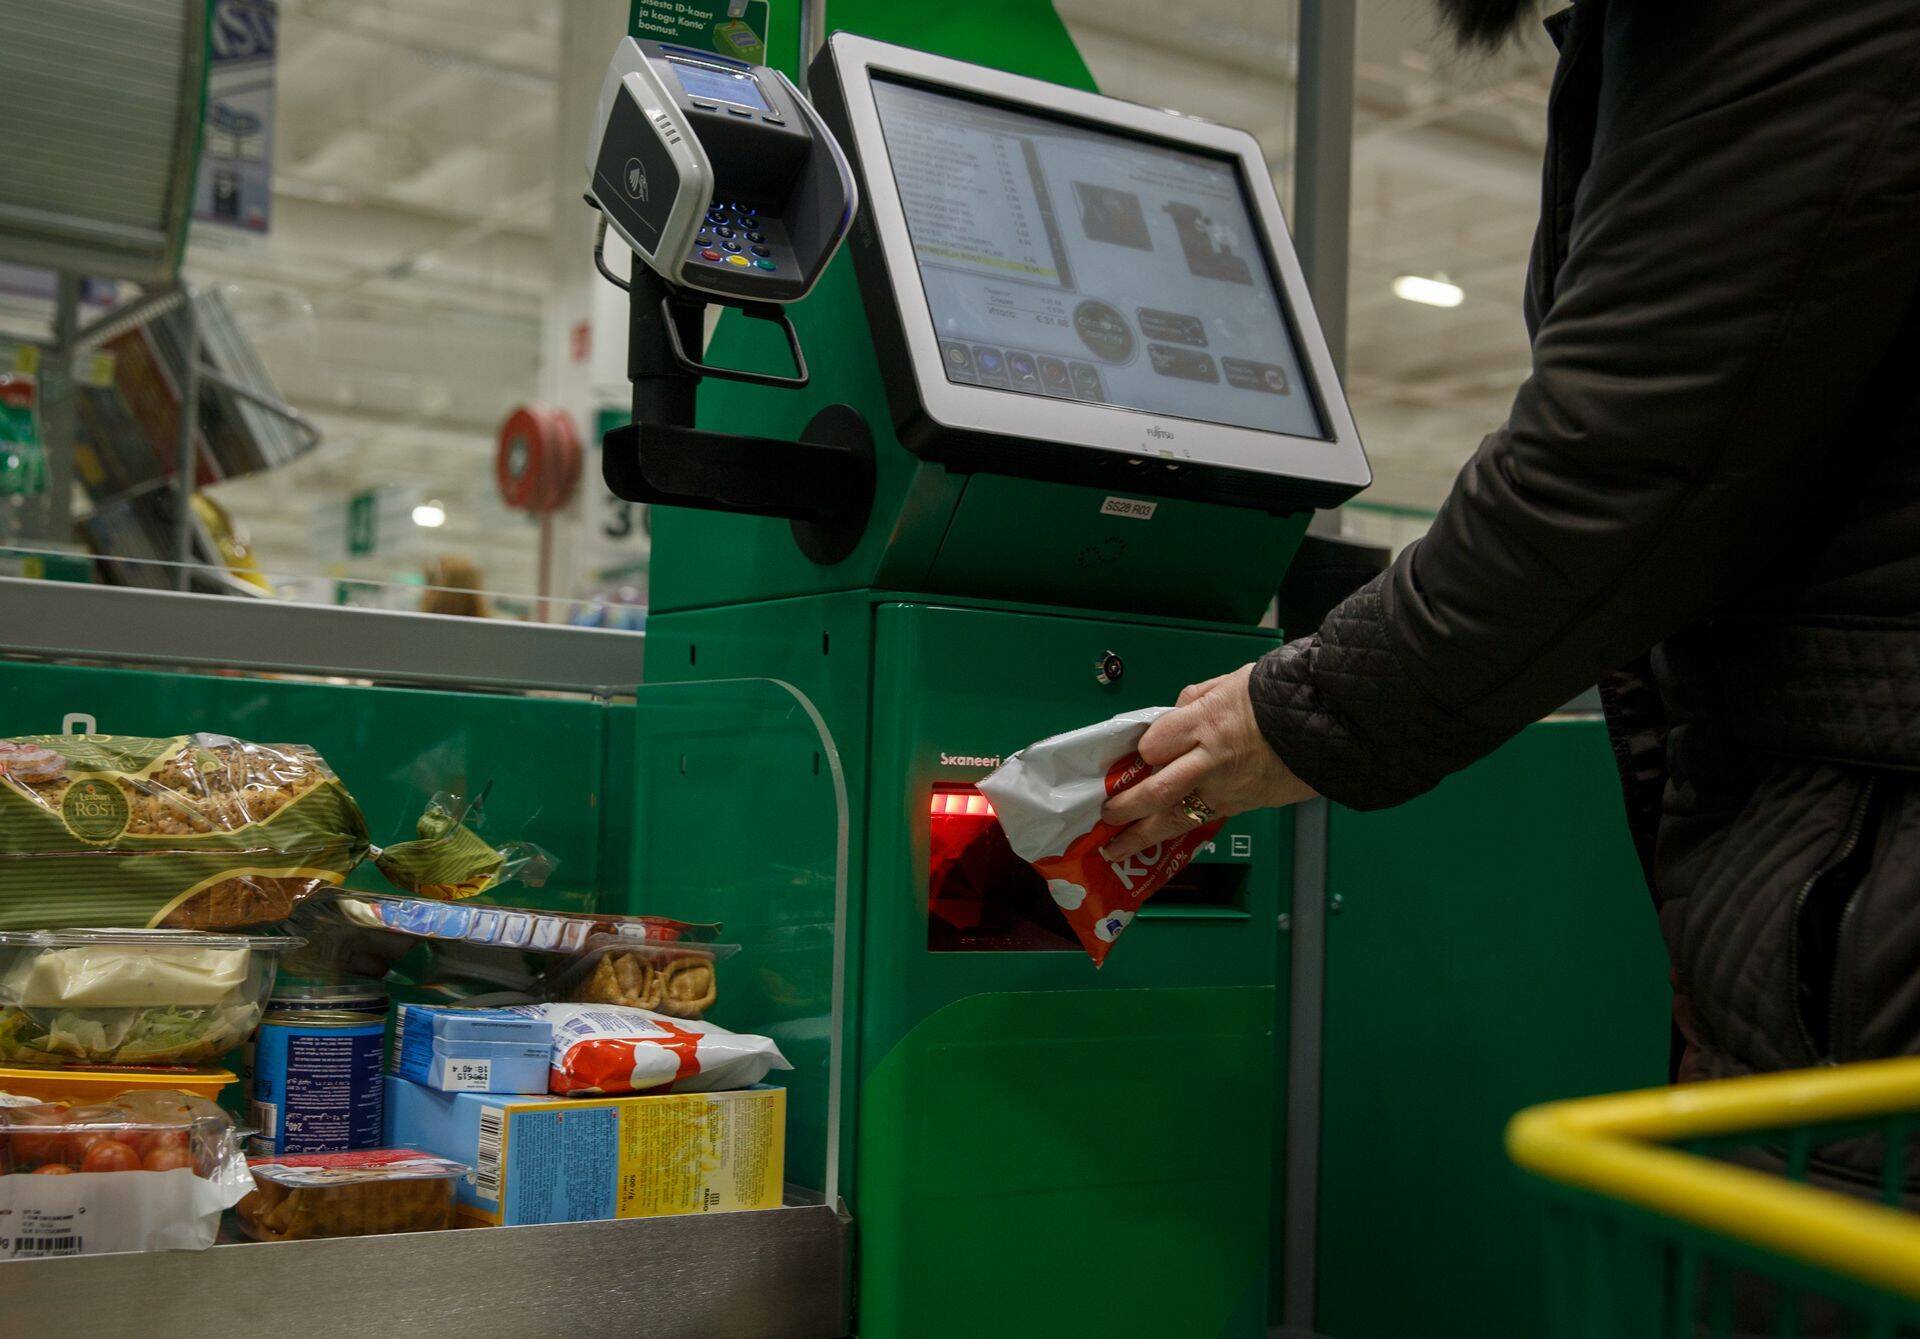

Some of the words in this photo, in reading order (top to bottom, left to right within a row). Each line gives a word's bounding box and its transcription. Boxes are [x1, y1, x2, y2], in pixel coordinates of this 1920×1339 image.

[639, 7, 650, 18] ja
[651, 9, 676, 24] kogu
[675, 3, 713, 20] ID-kaart
[638, 19, 680, 36] boonust.
[1146, 425, 1175, 440] FUJITSU
[940, 752, 1001, 767] Skaneeri
[285, 1121, 303, 1132] 240g
